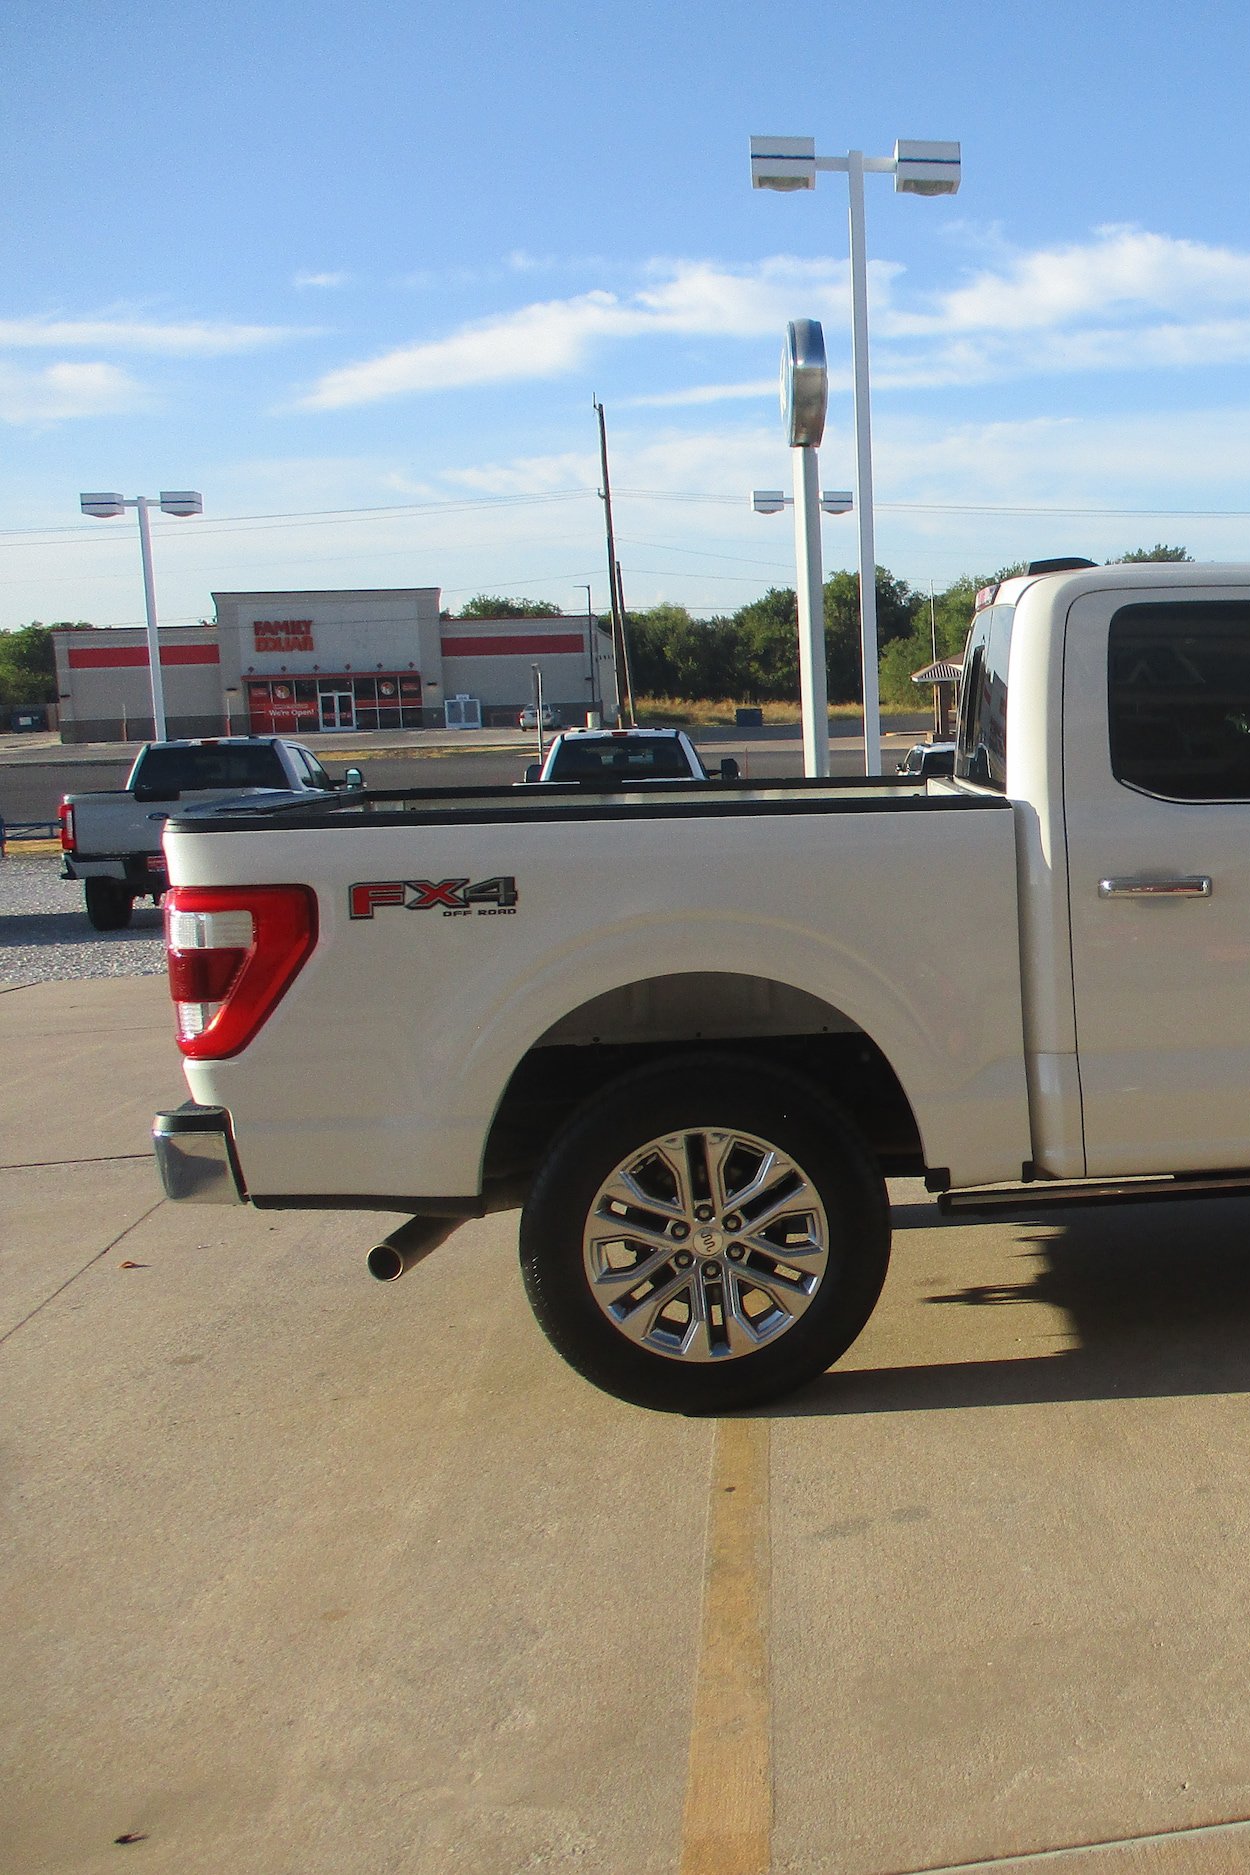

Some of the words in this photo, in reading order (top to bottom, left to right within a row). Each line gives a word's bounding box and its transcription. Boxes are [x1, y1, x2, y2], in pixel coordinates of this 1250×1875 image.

[253, 620, 313, 635] FAMILY
[255, 636, 315, 652] DOLLAR
[268, 709, 290, 717] We're
[291, 708, 315, 718] Open!
[349, 876, 518, 920] FX4
[442, 909, 473, 918] OFF
[477, 908, 518, 916] ROAD
